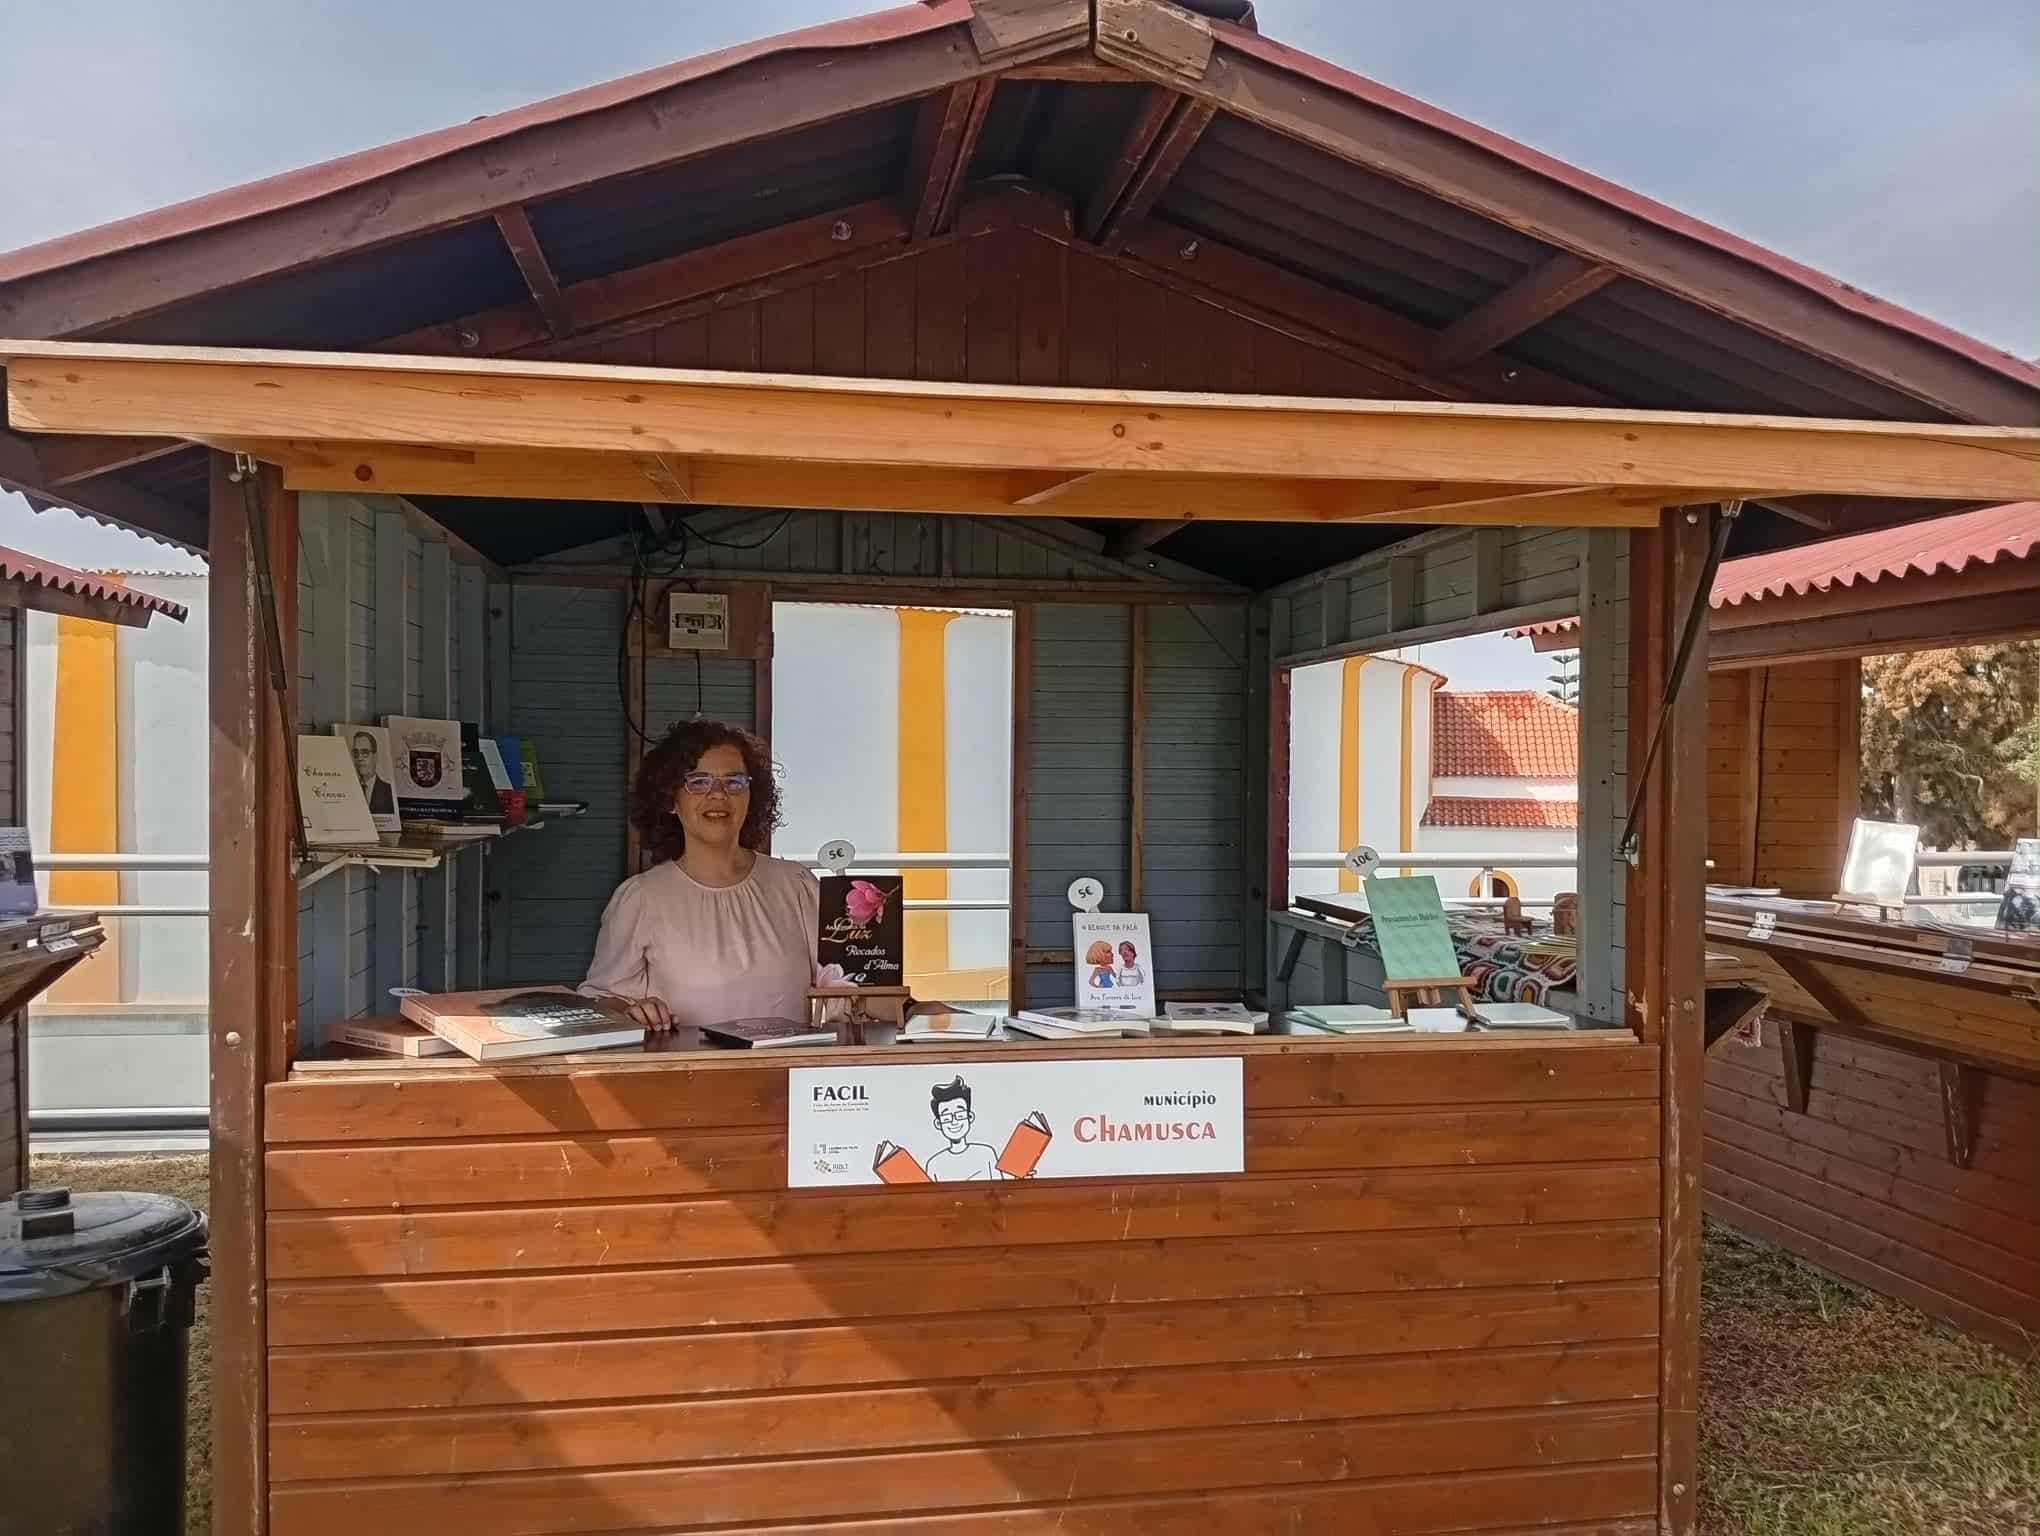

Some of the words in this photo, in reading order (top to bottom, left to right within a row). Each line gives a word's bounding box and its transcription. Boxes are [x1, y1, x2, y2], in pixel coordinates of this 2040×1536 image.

[828, 847, 845, 860] 5€
[1351, 851, 1374, 867] 10€
[1078, 884, 1094, 899] 5€
[820, 916, 873, 943] Luz
[845, 944, 886, 957] Recados
[813, 1085, 869, 1101] FACIL
